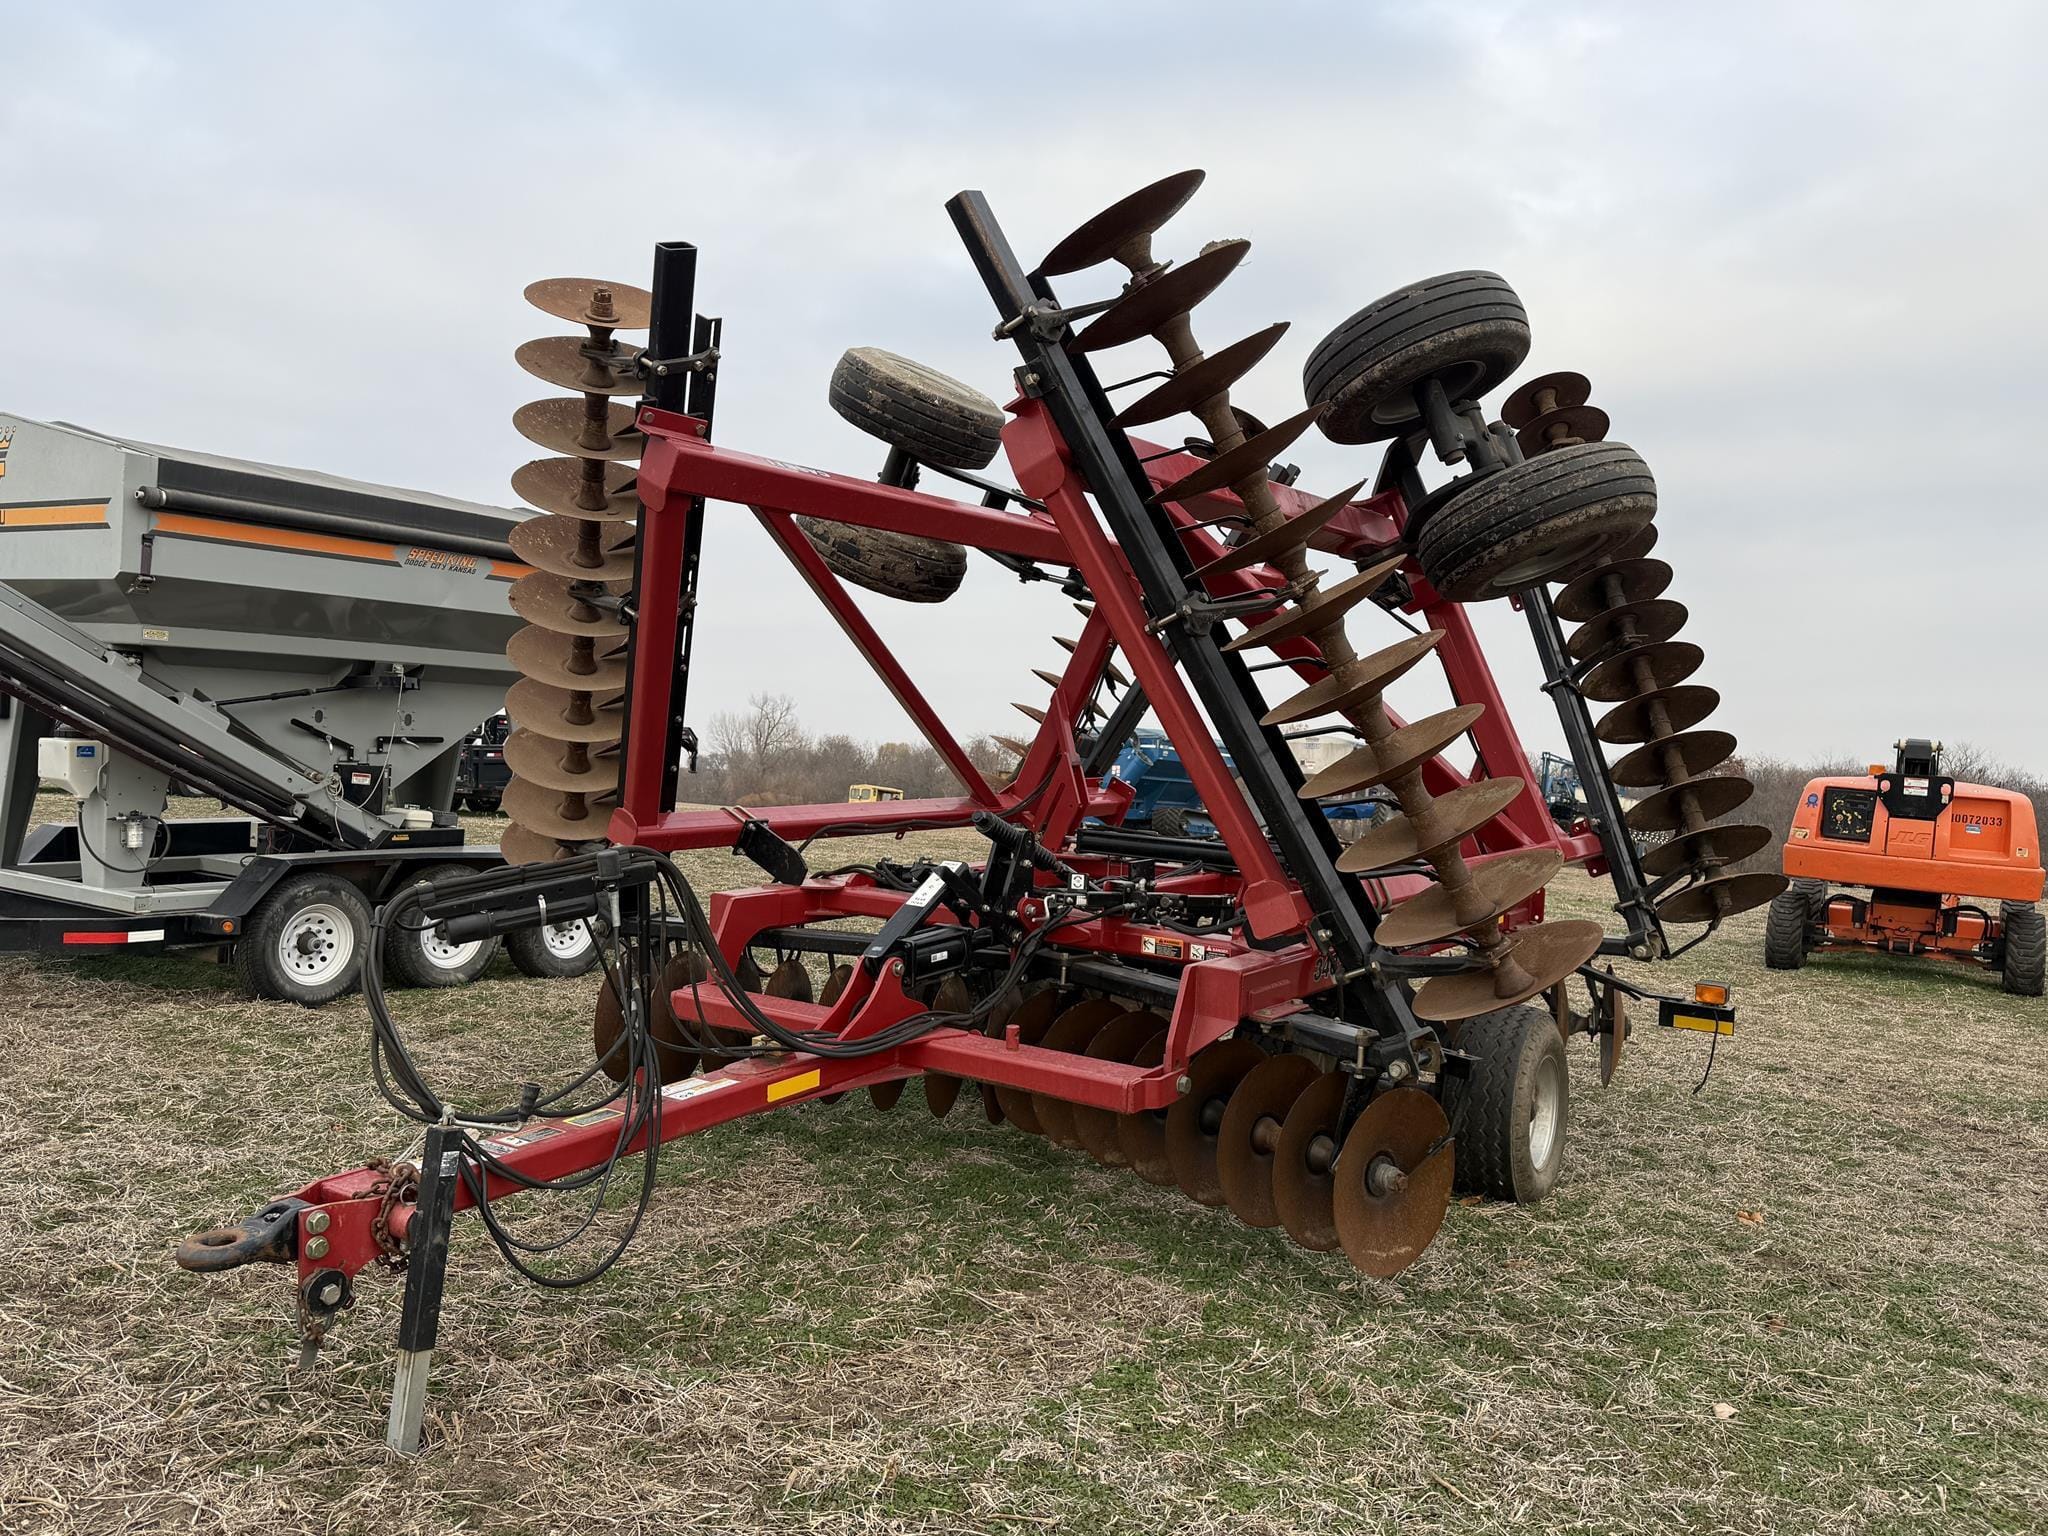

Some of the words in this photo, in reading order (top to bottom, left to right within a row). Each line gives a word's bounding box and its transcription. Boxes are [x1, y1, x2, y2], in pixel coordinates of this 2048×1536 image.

[408, 547, 447, 563] SPEED
[446, 553, 480, 568] KING
[404, 559, 428, 568] DODGE
[430, 562, 447, 570] CITY
[448, 565, 477, 575] KANSAS
[1889, 830, 1932, 844] JLG
